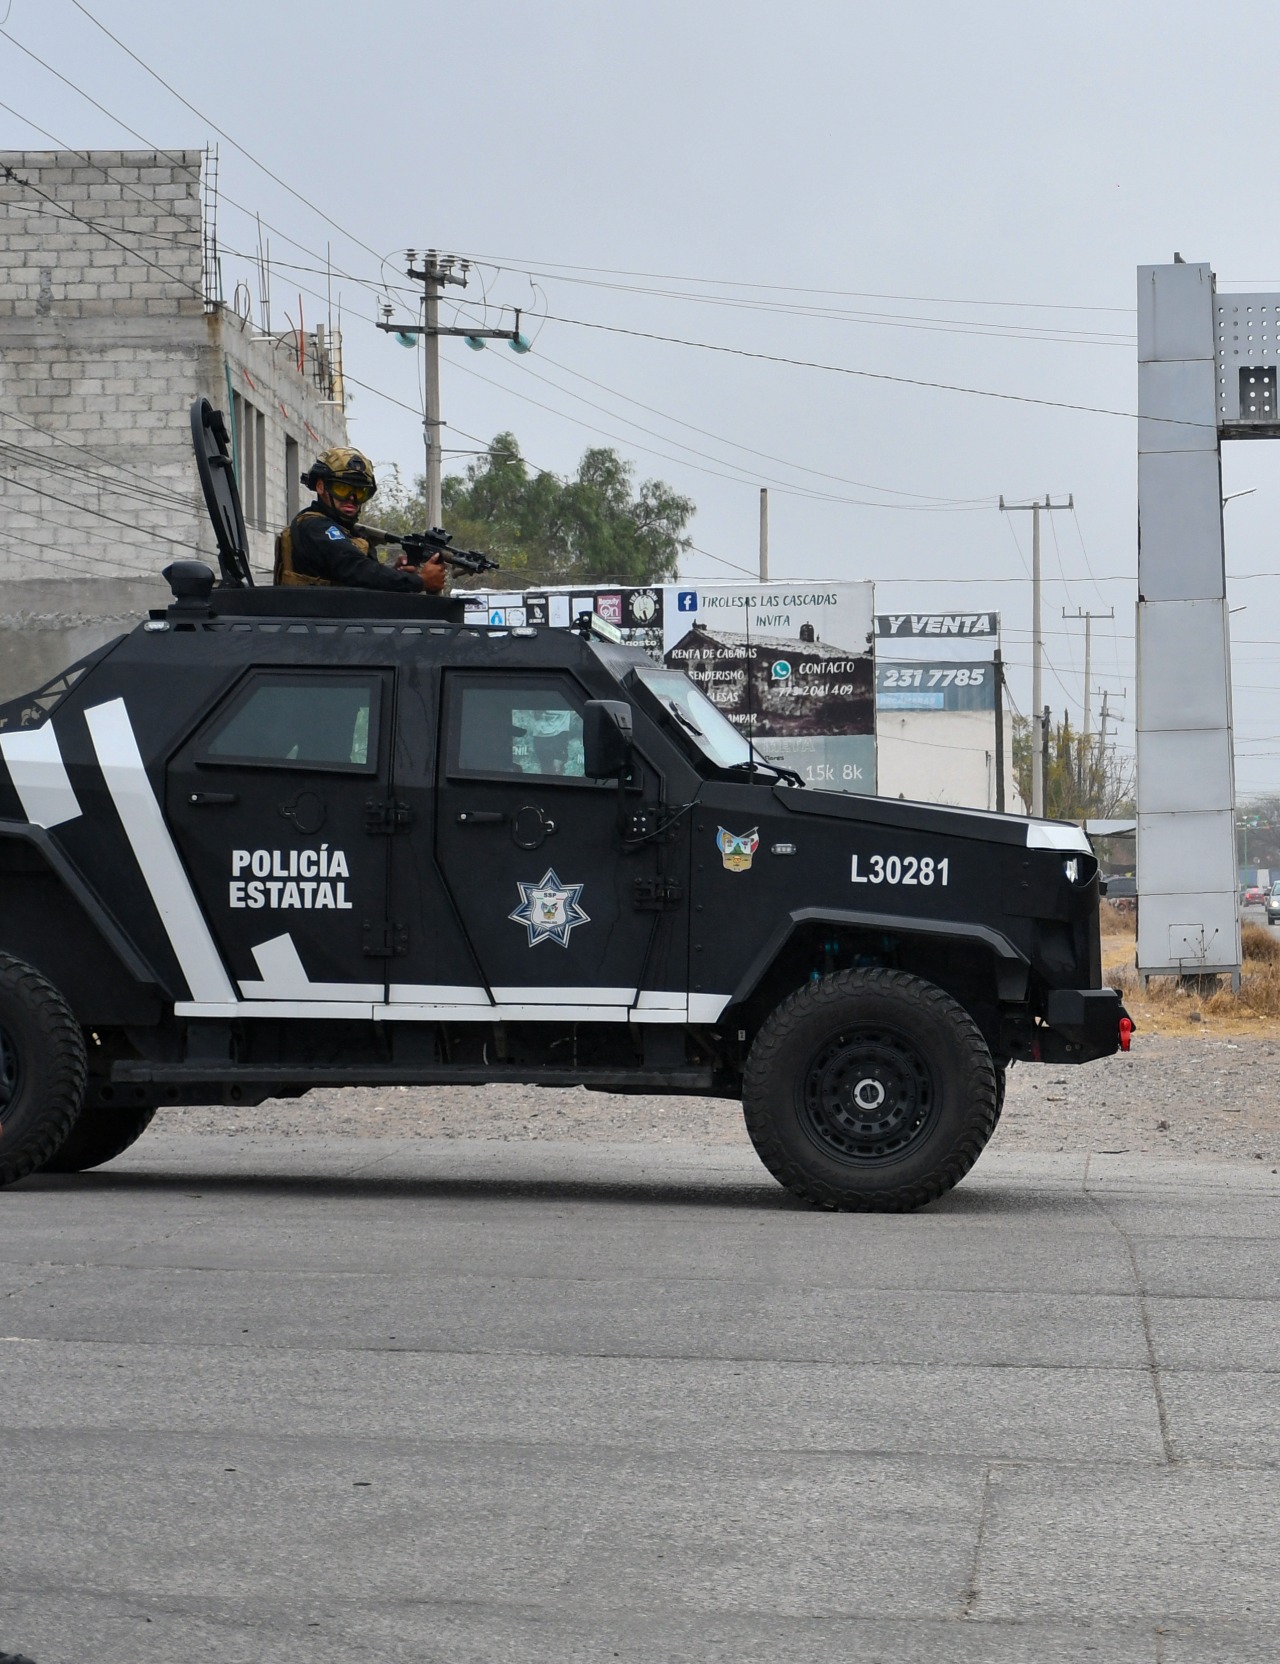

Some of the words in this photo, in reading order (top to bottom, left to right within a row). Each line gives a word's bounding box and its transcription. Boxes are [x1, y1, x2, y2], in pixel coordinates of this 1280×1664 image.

[701, 595, 757, 608] TIROLESAS
[760, 595, 780, 607] LAS
[783, 593, 838, 606] CASCADAS
[756, 614, 791, 627] INVITA
[888, 616, 906, 634] Y
[910, 614, 991, 634] VENTA
[671, 648, 701, 660] RENTA
[702, 648, 715, 660] DE
[716, 647, 758, 660] CABAÑAS
[688, 669, 745, 682] SENDERISMO
[798, 661, 855, 675] CONTACTO
[883, 668, 924, 687] 231
[927, 668, 985, 687] 7785
[831, 684, 854, 697] 409
[806, 764, 835, 781] 15k
[842, 764, 863, 780] 8k
[232, 843, 350, 878] POLICÍA
[851, 854, 949, 887] L30281
[229, 881, 353, 909] ESTATAL
